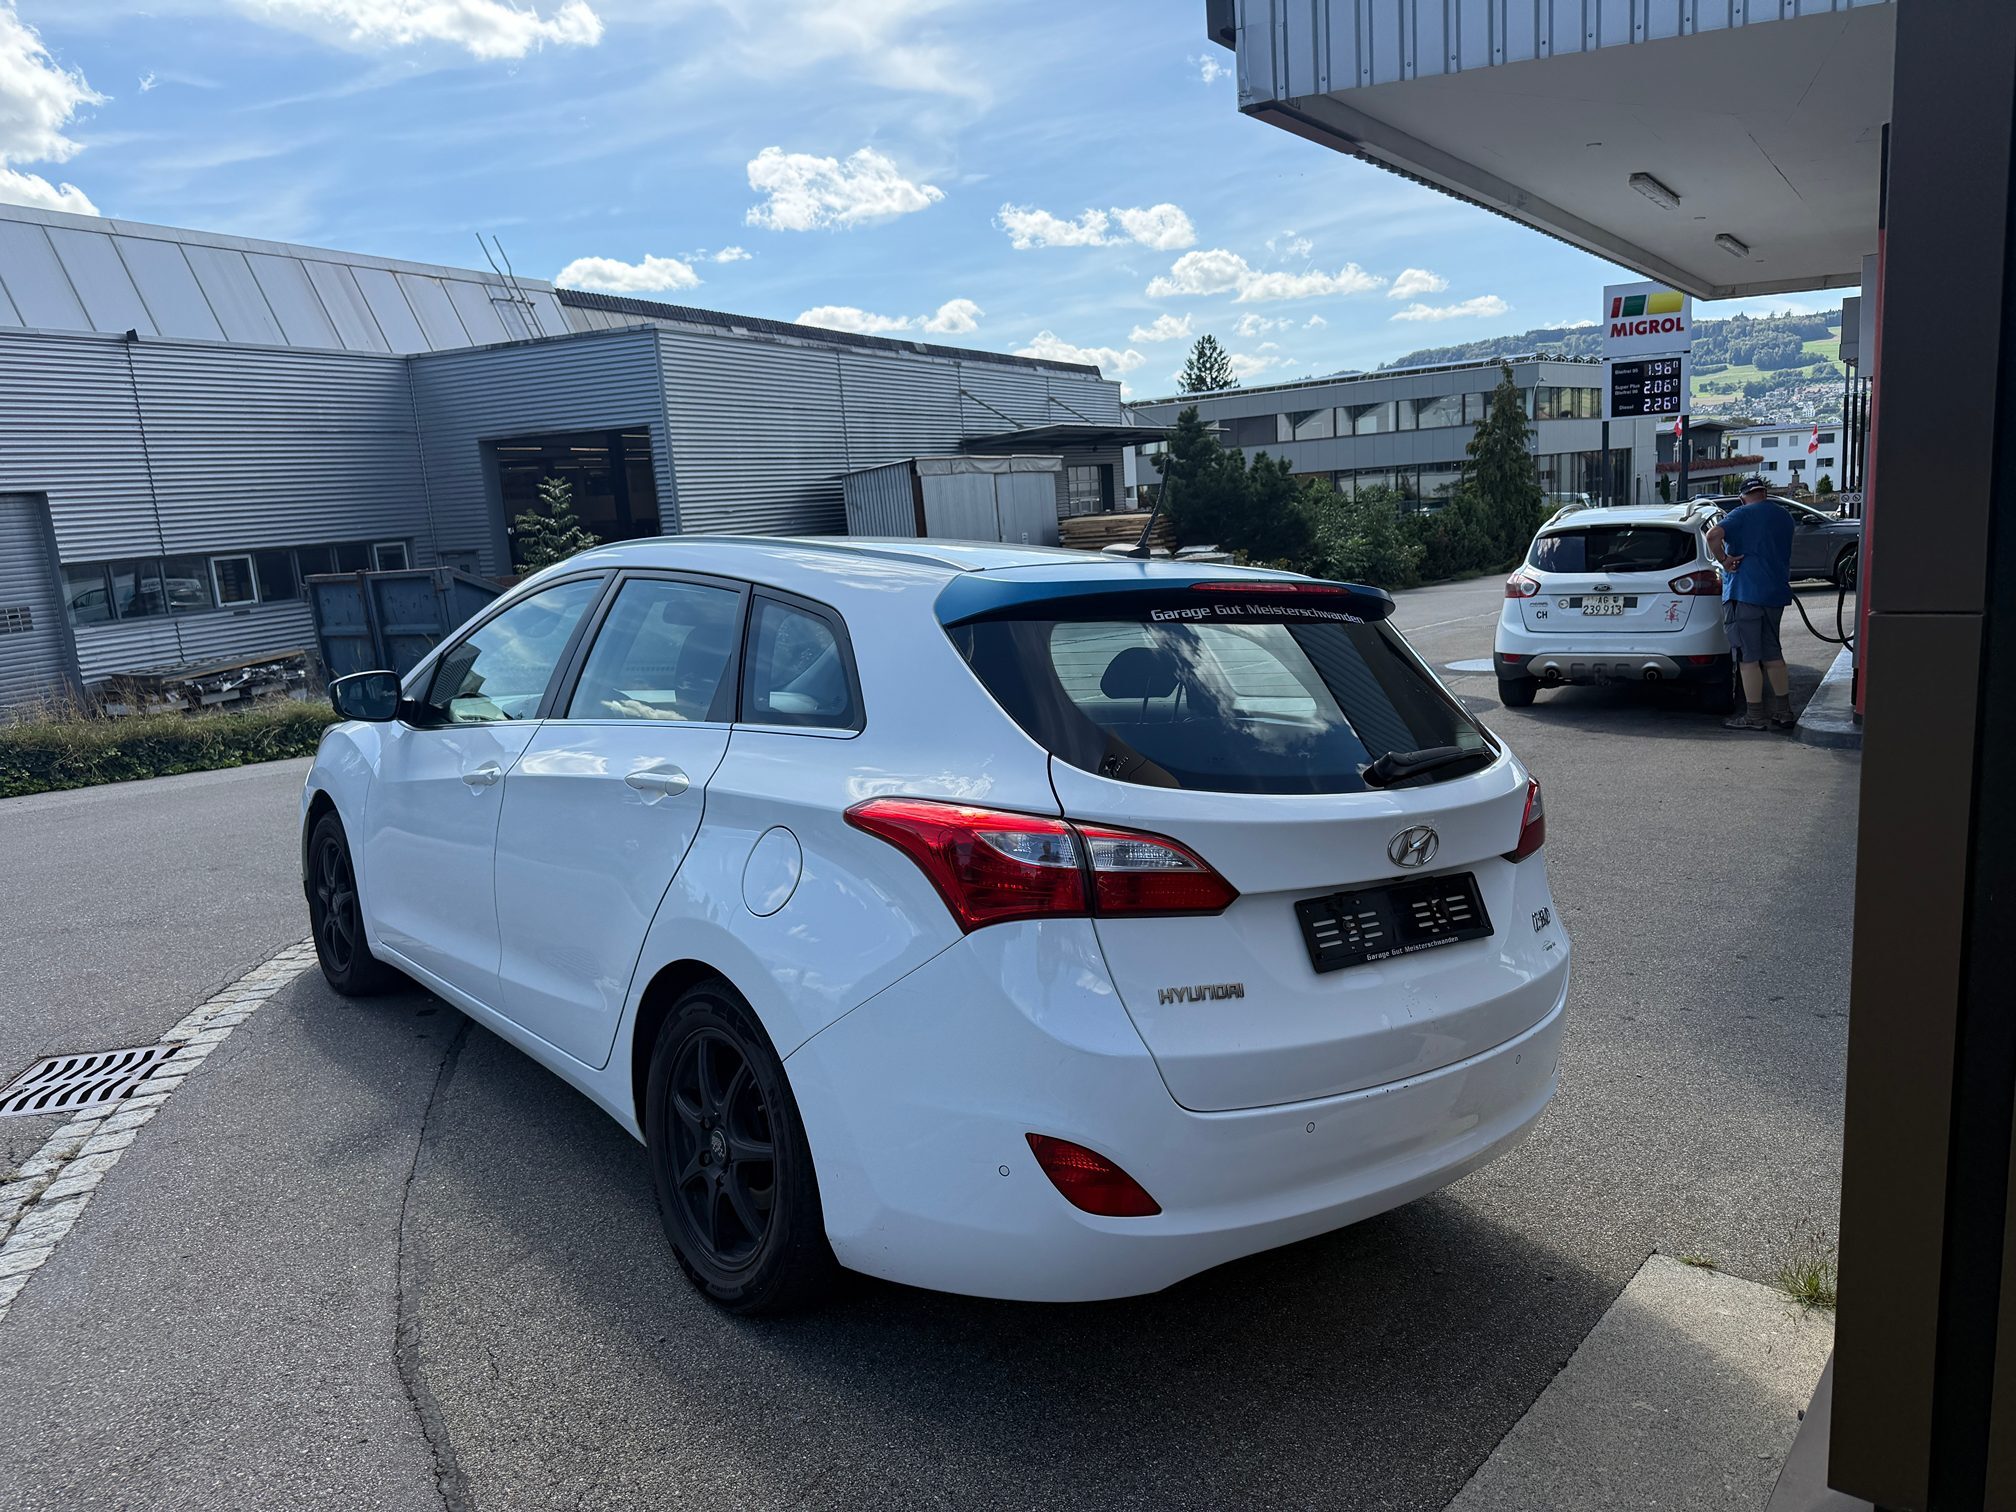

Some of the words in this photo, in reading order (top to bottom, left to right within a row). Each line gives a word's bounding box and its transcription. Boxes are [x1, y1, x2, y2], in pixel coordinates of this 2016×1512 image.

[1610, 317, 1685, 338] MIGROL
[1150, 608, 1212, 621] Garage
[1214, 604, 1245, 615] Gut
[1246, 604, 1365, 625] Meisterschwanden
[1536, 610, 1548, 619] CH
[1366, 950, 1390, 961] Garage
[1391, 947, 1404, 956] Gut
[1404, 936, 1459, 953] Meisterschwanden
[1158, 983, 1245, 1005] HYUNDAI
